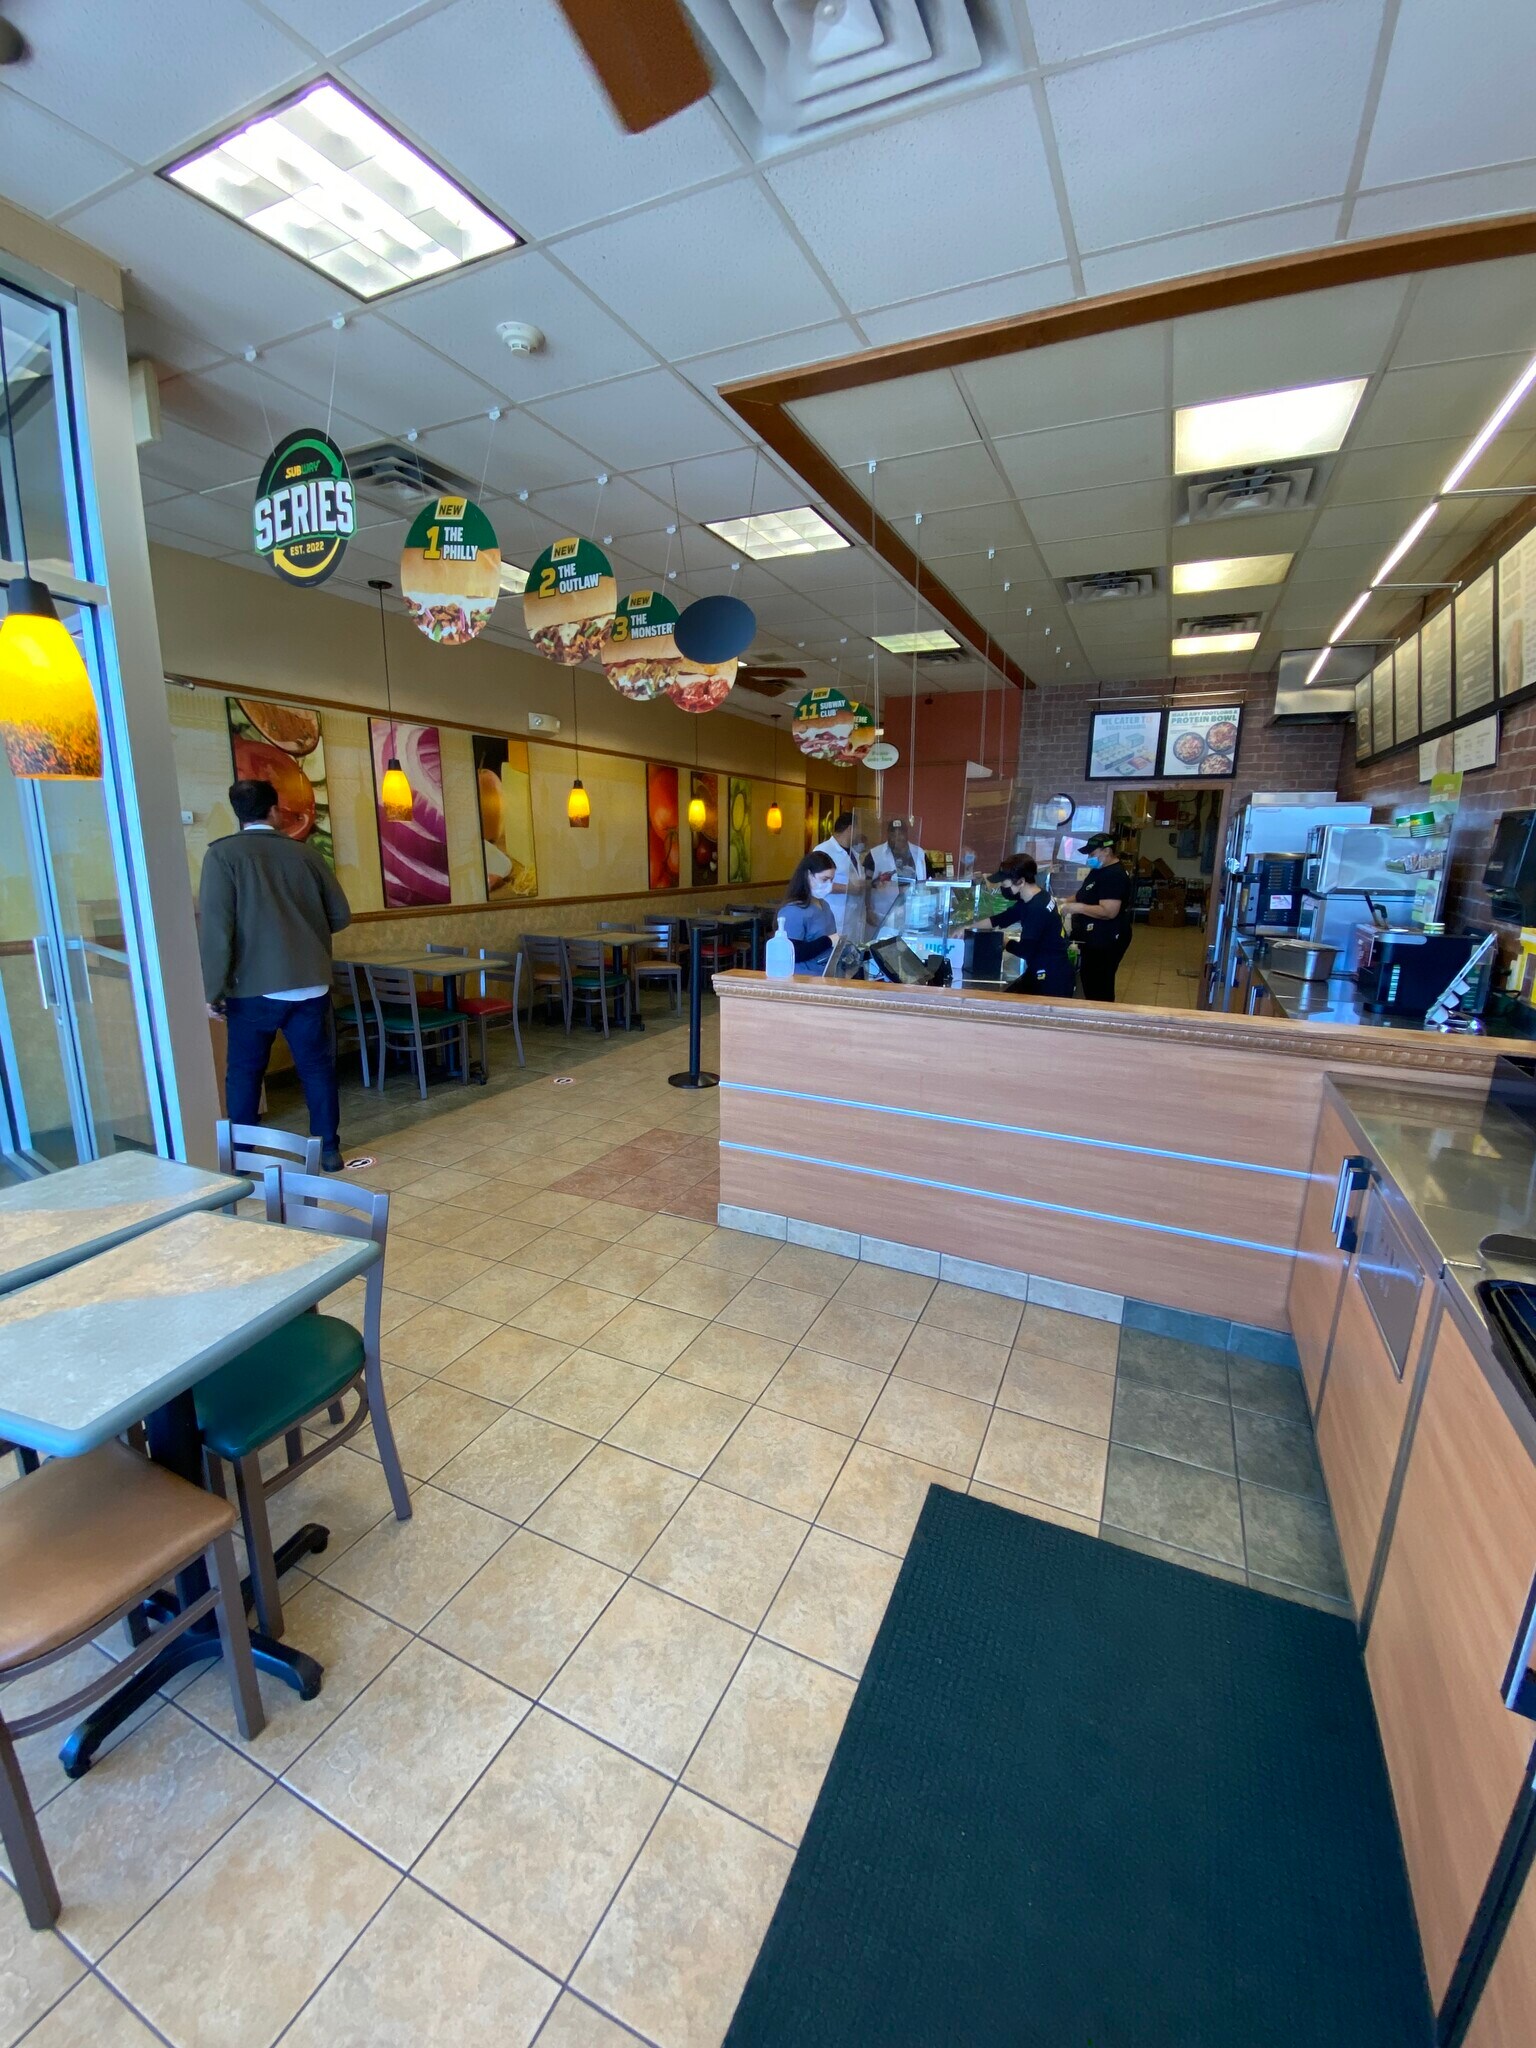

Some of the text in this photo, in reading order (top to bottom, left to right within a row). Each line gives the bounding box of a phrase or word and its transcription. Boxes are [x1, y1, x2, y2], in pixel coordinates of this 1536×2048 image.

[285, 460, 321, 479] SUBWAY
[254, 480, 354, 550] SERIES
[438, 504, 463, 516] NEW
[444, 526, 464, 543] THE
[290, 541, 325, 556] EST. 2022
[423, 526, 441, 560] 1
[553, 543, 577, 558] NEW
[443, 545, 479, 561] PHILLY
[558, 563, 577, 578] THE
[538, 567, 557, 599] 2
[559, 575, 600, 595] OUTLAW
[630, 595, 651, 607] NEW
[631, 613, 648, 626] THE
[612, 616, 629, 642] 3
[631, 622, 674, 640] MONSTER
[799, 702, 819, 720] 11
[820, 700, 846, 710] SUBWAY
[820, 709, 837, 718] CLUB
[1114, 716, 1140, 724] CATER
[1171, 714, 1237, 724] PROTEIN BOWL
